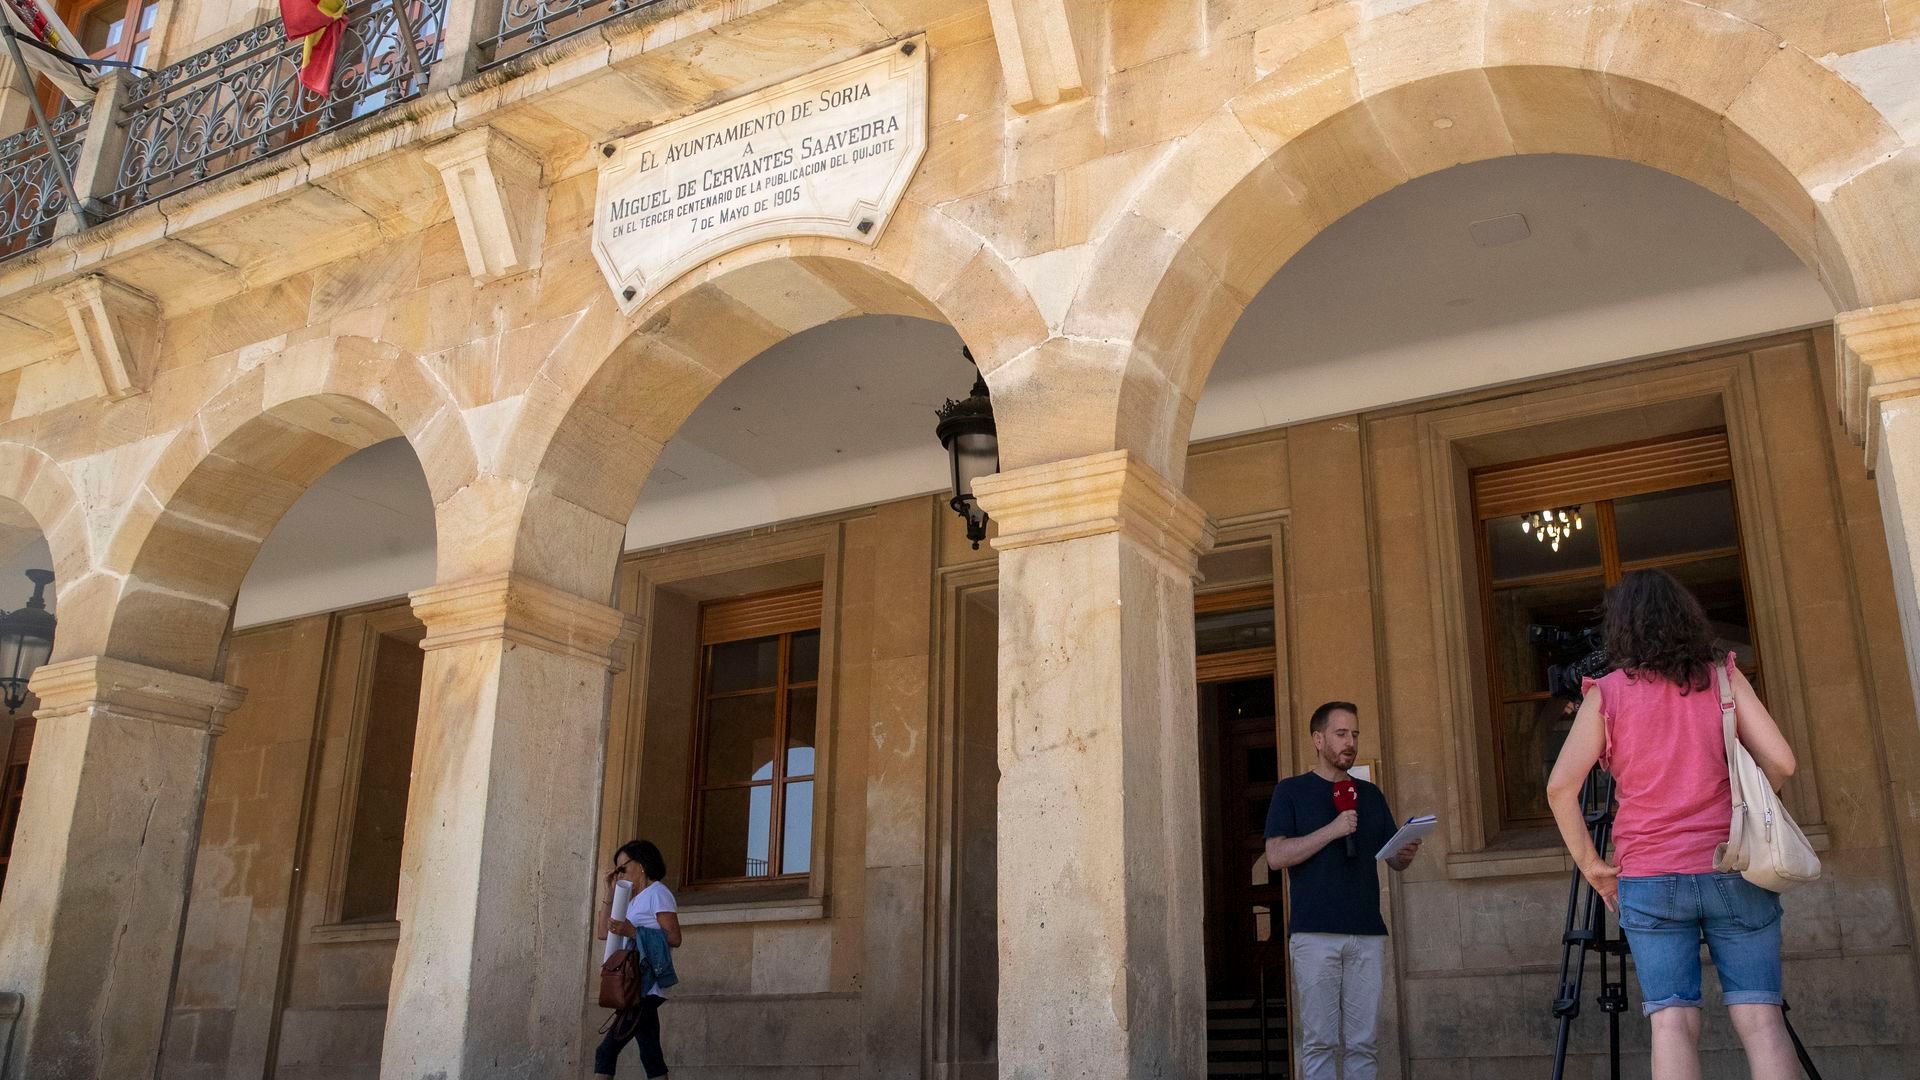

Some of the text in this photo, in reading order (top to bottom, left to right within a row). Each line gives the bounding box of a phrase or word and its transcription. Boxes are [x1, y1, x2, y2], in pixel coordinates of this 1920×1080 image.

[665, 110, 785, 164] AYUNTAMIENTO
[791, 100, 813, 121] DE
[819, 83, 871, 112] SORIA
[742, 141, 754, 157] A
[610, 115, 899, 222] MIGUEL DE CERVANTES SAAVEDRA
[613, 139, 895, 238] EN EL TERCER CENTENARIO DE LA PUBLICACION DEL QUIJOTE
[691, 185, 800, 233] 7 DE MAYO DE 1905
